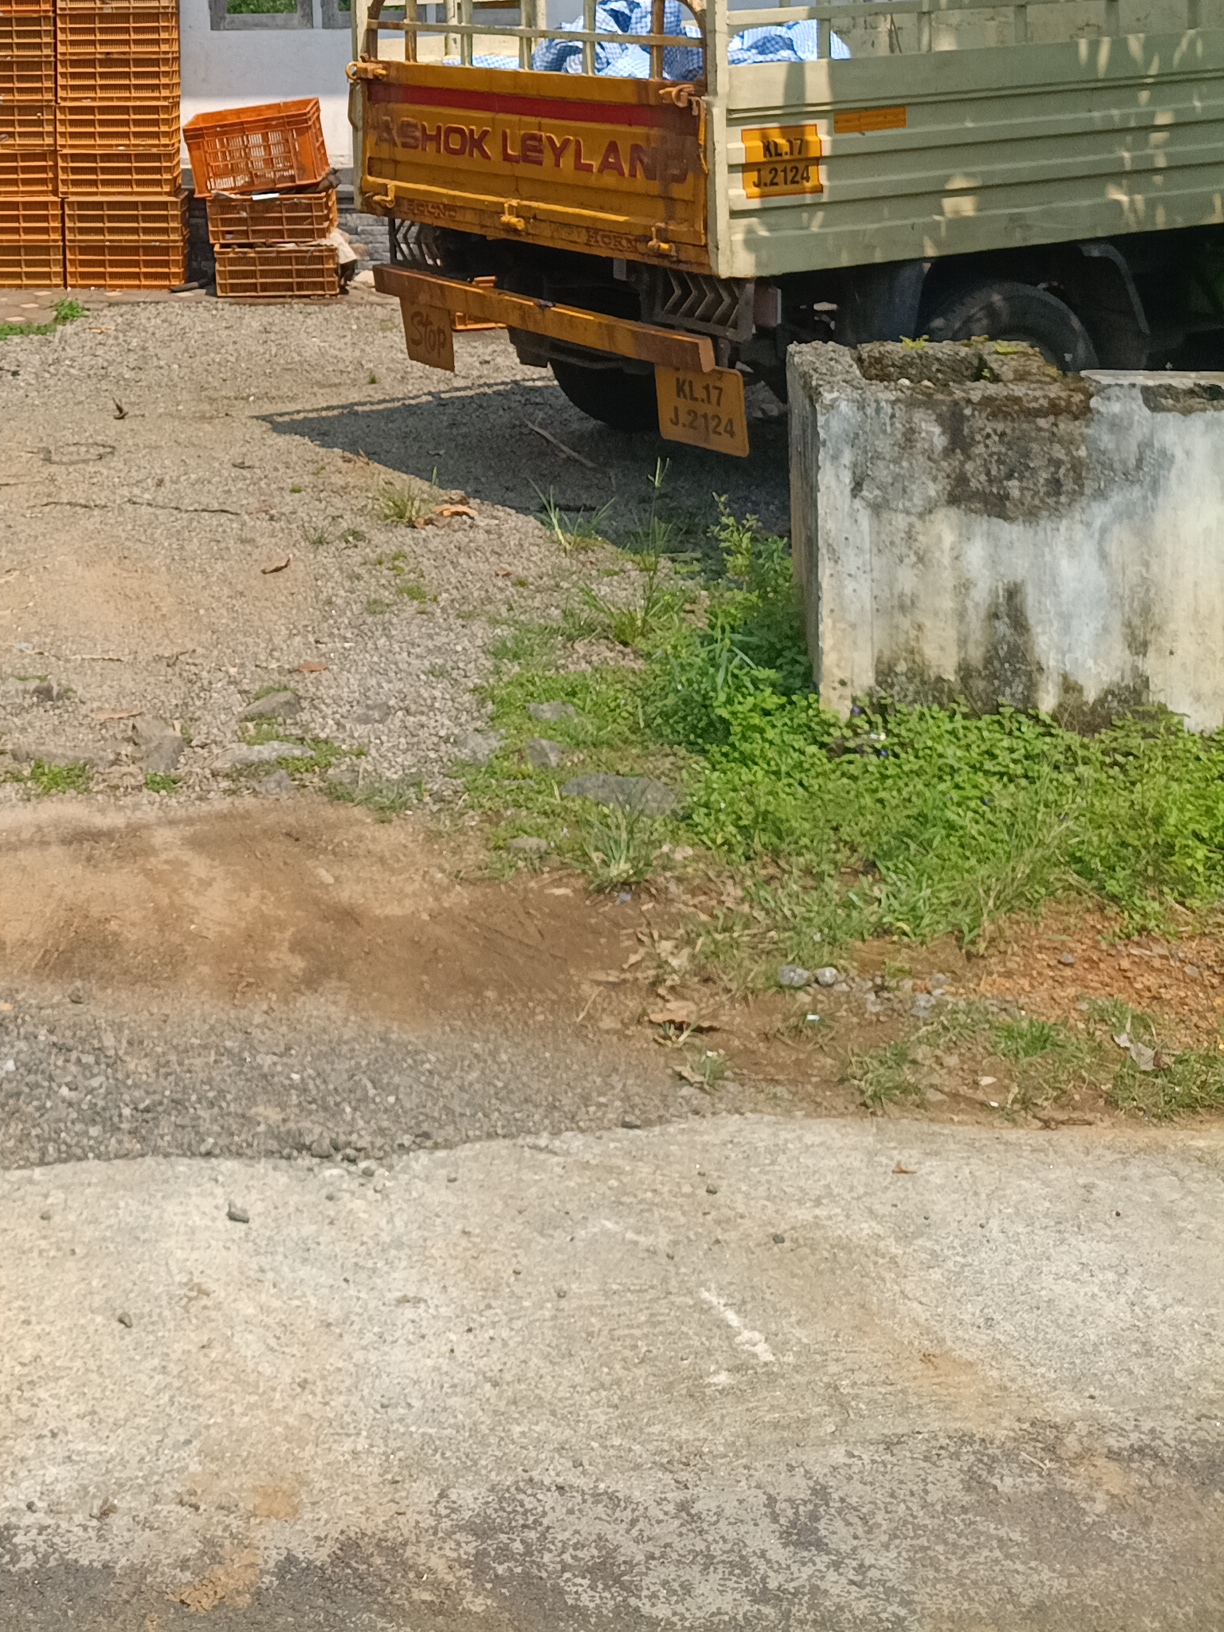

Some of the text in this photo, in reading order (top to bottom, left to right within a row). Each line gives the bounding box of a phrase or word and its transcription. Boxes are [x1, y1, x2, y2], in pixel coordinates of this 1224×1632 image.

[374, 115, 493, 160] ASHOK
[761, 137, 805, 159] KL.17
[752, 164, 811, 189] J.2124
[585, 228, 638, 254] HORN
[410, 310, 447, 359] Stop
[675, 376, 724, 408] KL.17
[669, 405, 736, 439] J.2124
